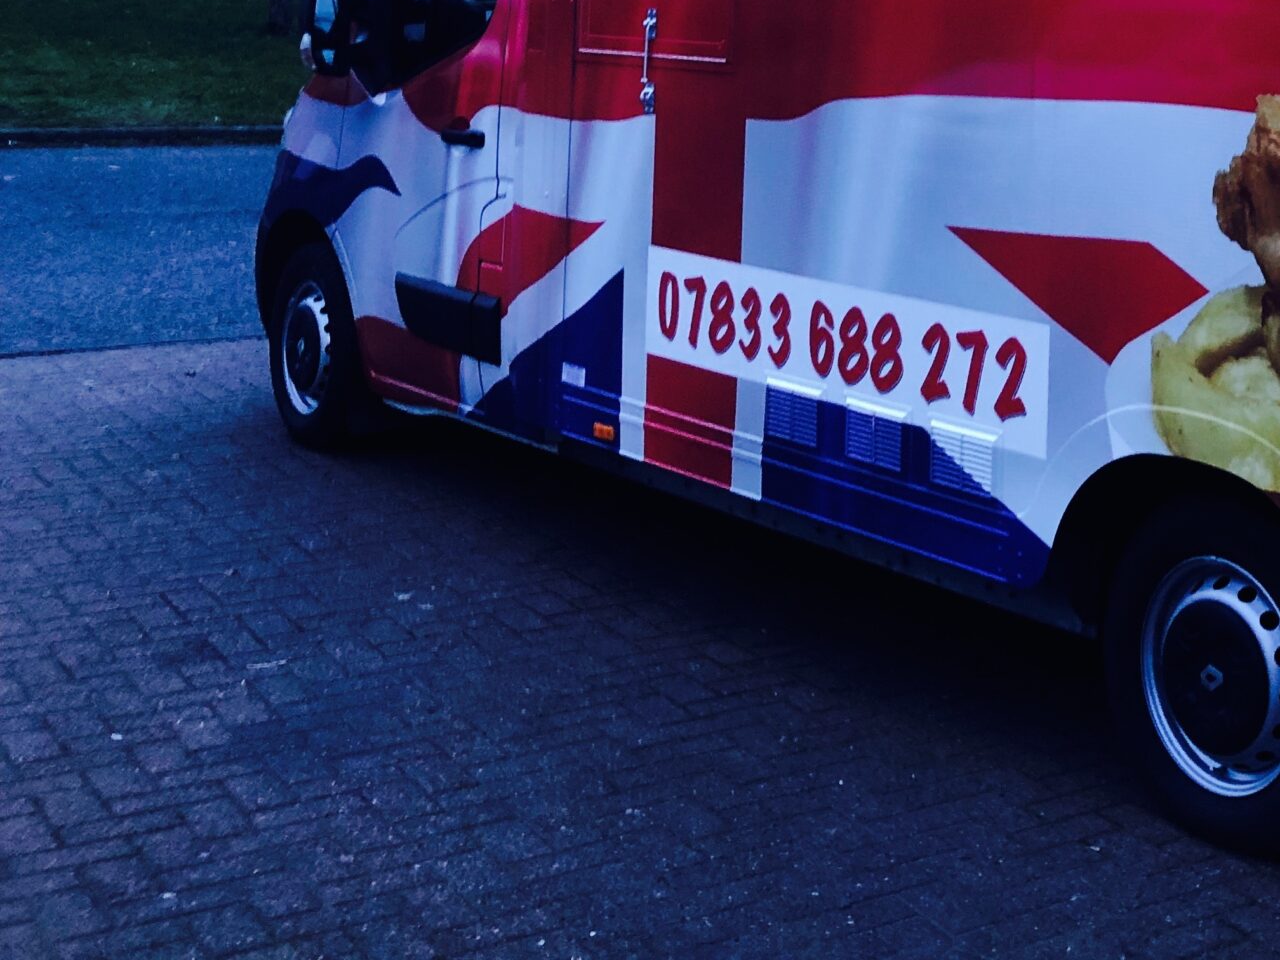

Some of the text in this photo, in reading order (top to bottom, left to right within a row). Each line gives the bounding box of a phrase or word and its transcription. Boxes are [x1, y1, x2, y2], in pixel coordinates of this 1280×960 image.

[658, 271, 1028, 421] 07833 688 272
